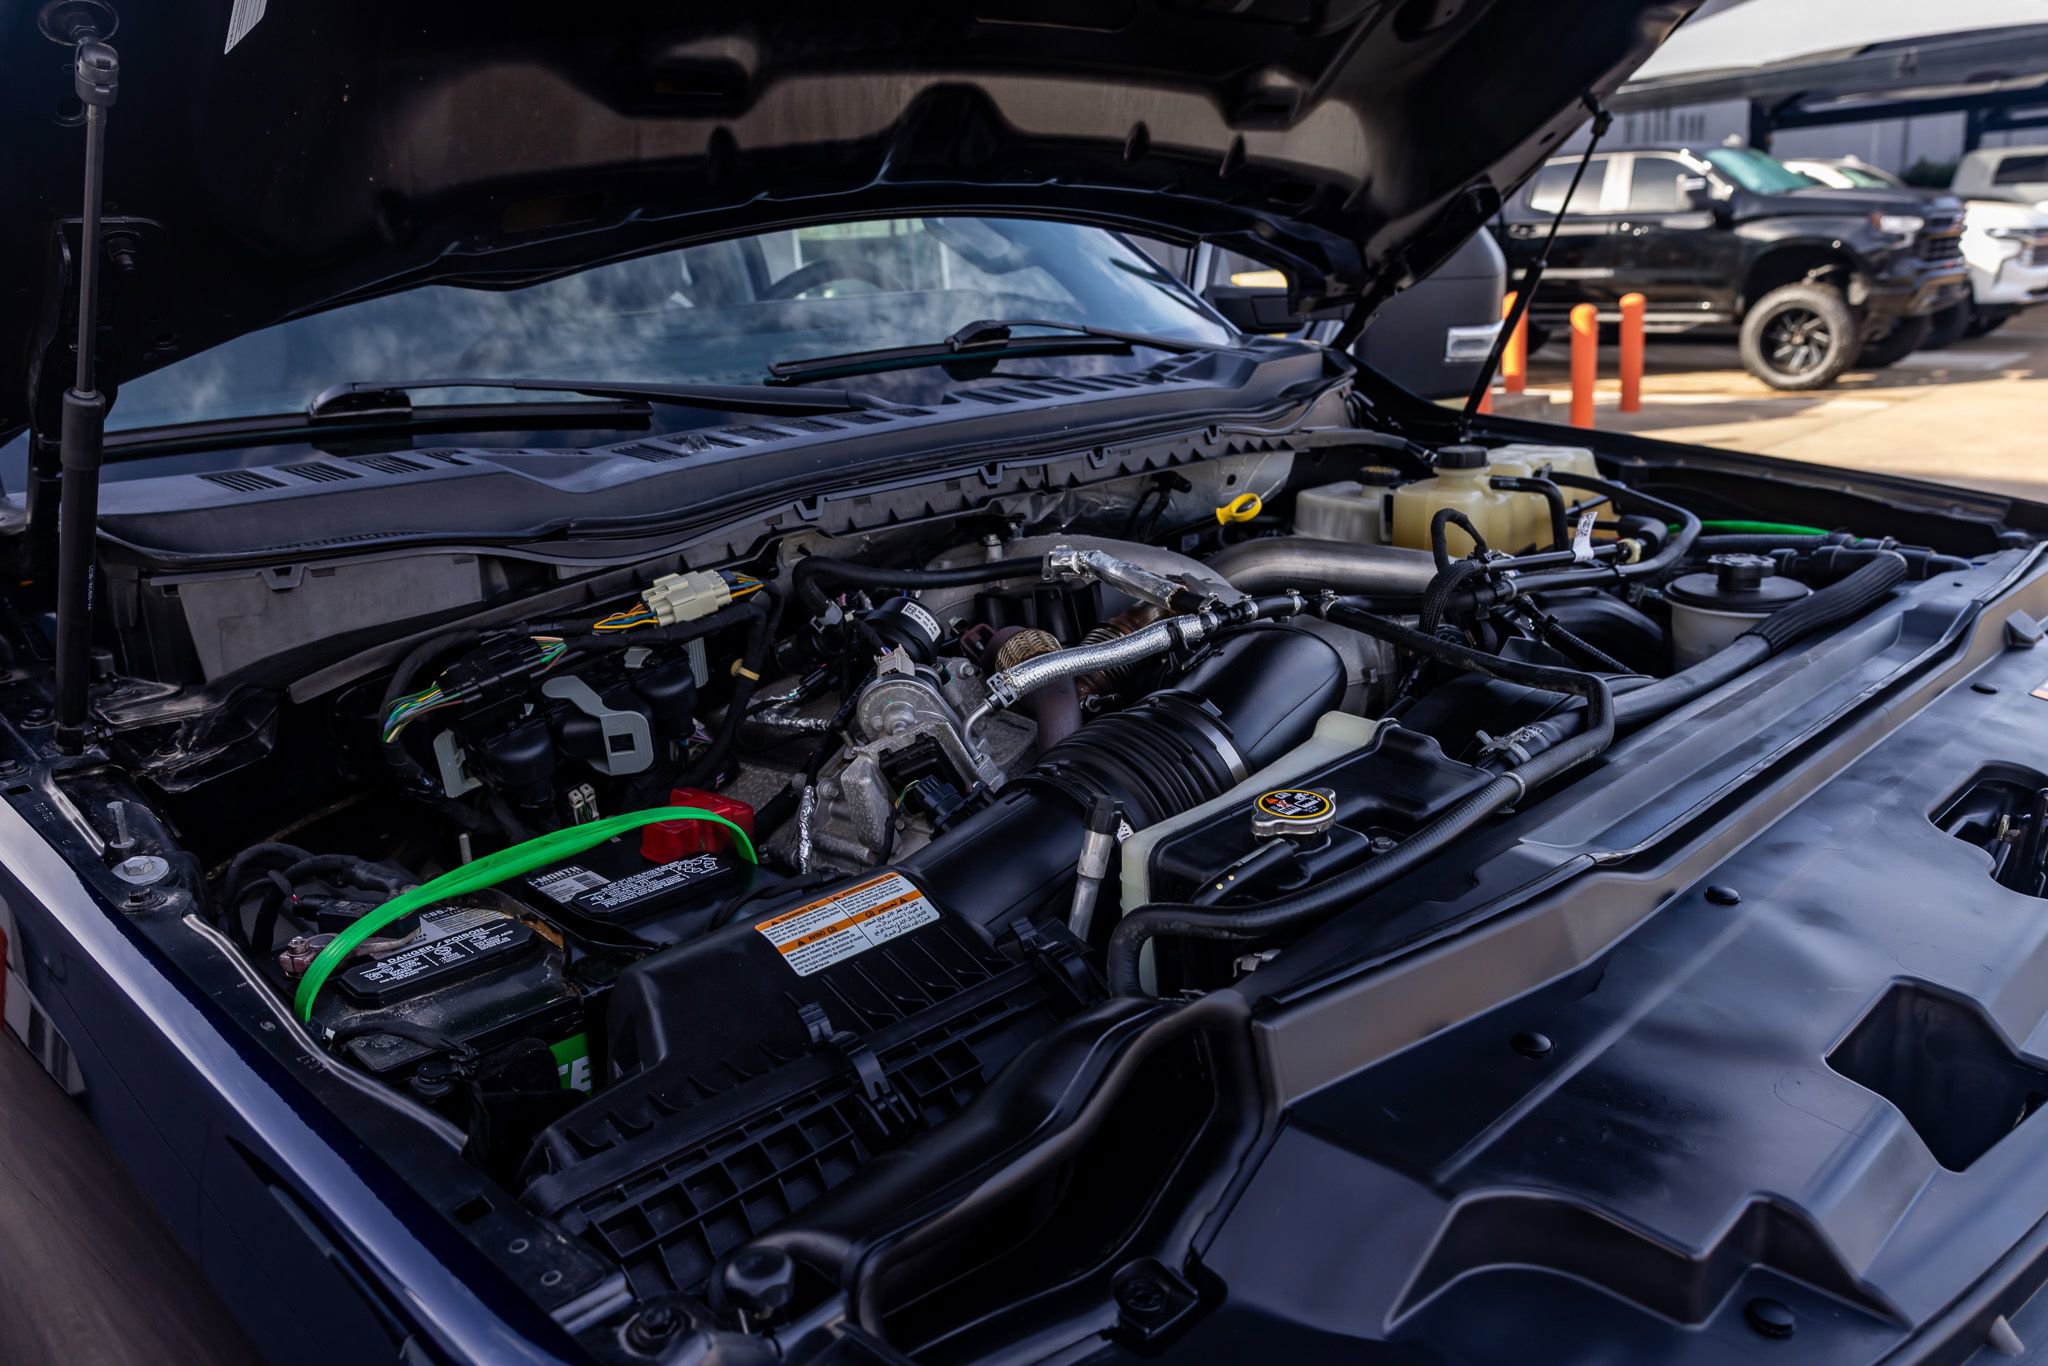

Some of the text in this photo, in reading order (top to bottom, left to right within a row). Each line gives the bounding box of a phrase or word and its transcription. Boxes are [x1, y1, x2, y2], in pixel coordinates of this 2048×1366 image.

[386, 944, 435, 965] DANGER
[444, 927, 486, 945] POISON
[808, 931, 826, 941] AVISO
